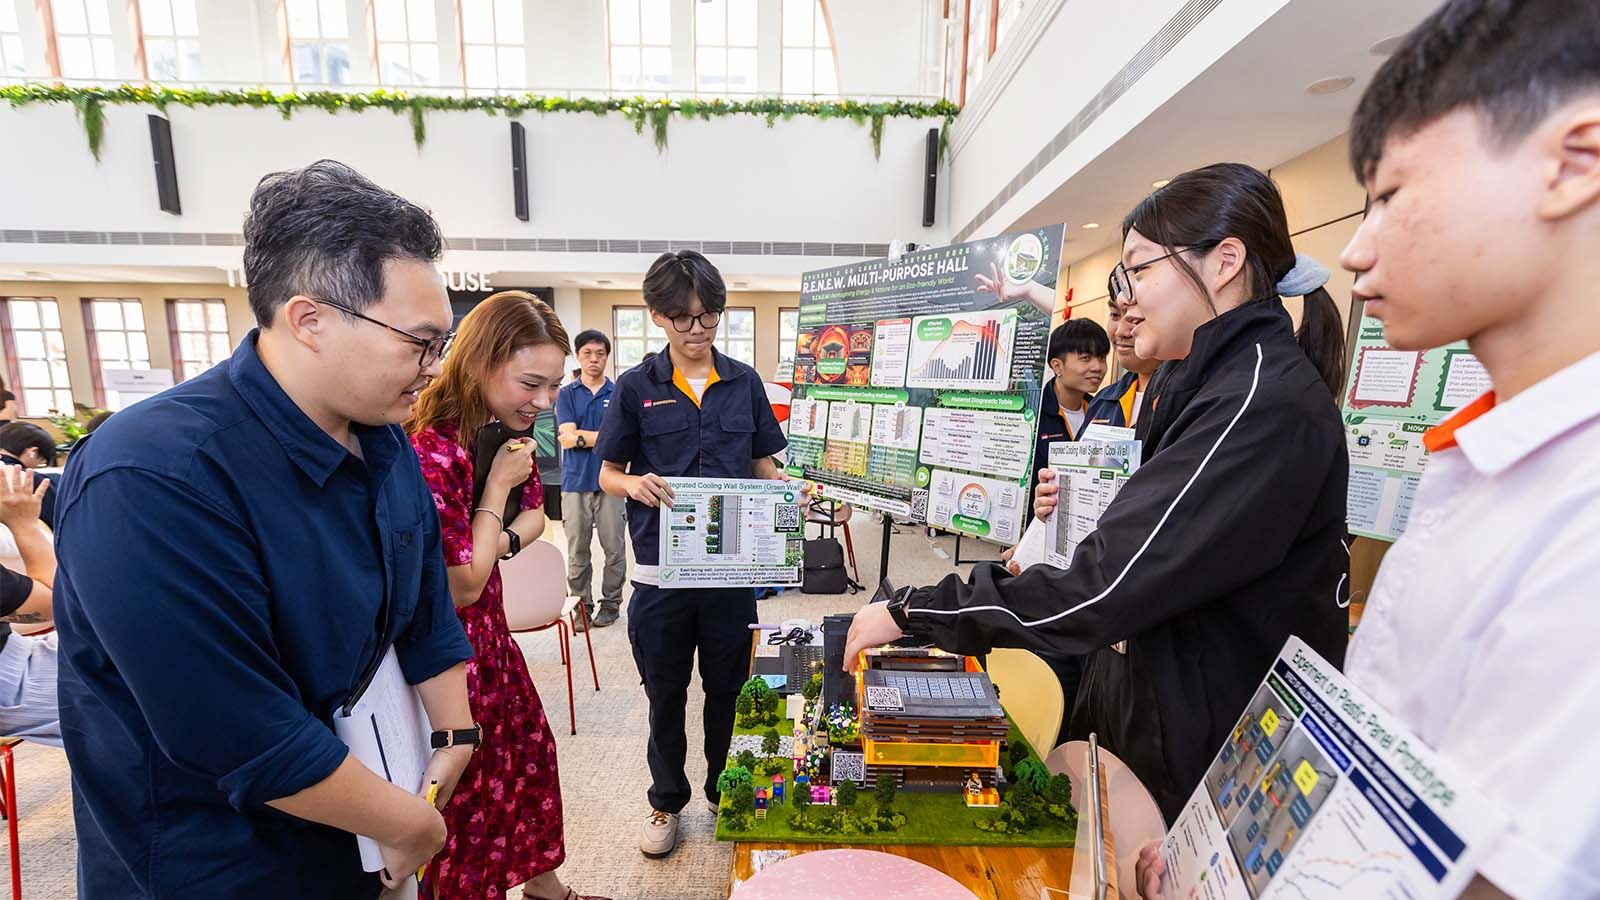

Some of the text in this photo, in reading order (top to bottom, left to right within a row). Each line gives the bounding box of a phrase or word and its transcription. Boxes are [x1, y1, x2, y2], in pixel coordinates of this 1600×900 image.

[802, 276, 846, 294] R.E.N.E.W.
[847, 261, 935, 288] MULTI-PURPOSE
[936, 255, 969, 275] HALL
[906, 280, 937, 290] Eco-friendly
[937, 277, 955, 285] World
[1088, 445, 1103, 457] System
[669, 481, 696, 490] tegrated
[697, 480, 723, 490] Cooling
[723, 481, 738, 489] Wall
[739, 481, 762, 491] System
[763, 483, 785, 491] (Green
[1292, 648, 1329, 690] Experiment
[1325, 682, 1338, 699] on
[1336, 688, 1366, 724] Plastic
[1363, 713, 1398, 752] Panel
[1393, 739, 1457, 807] Prototype
